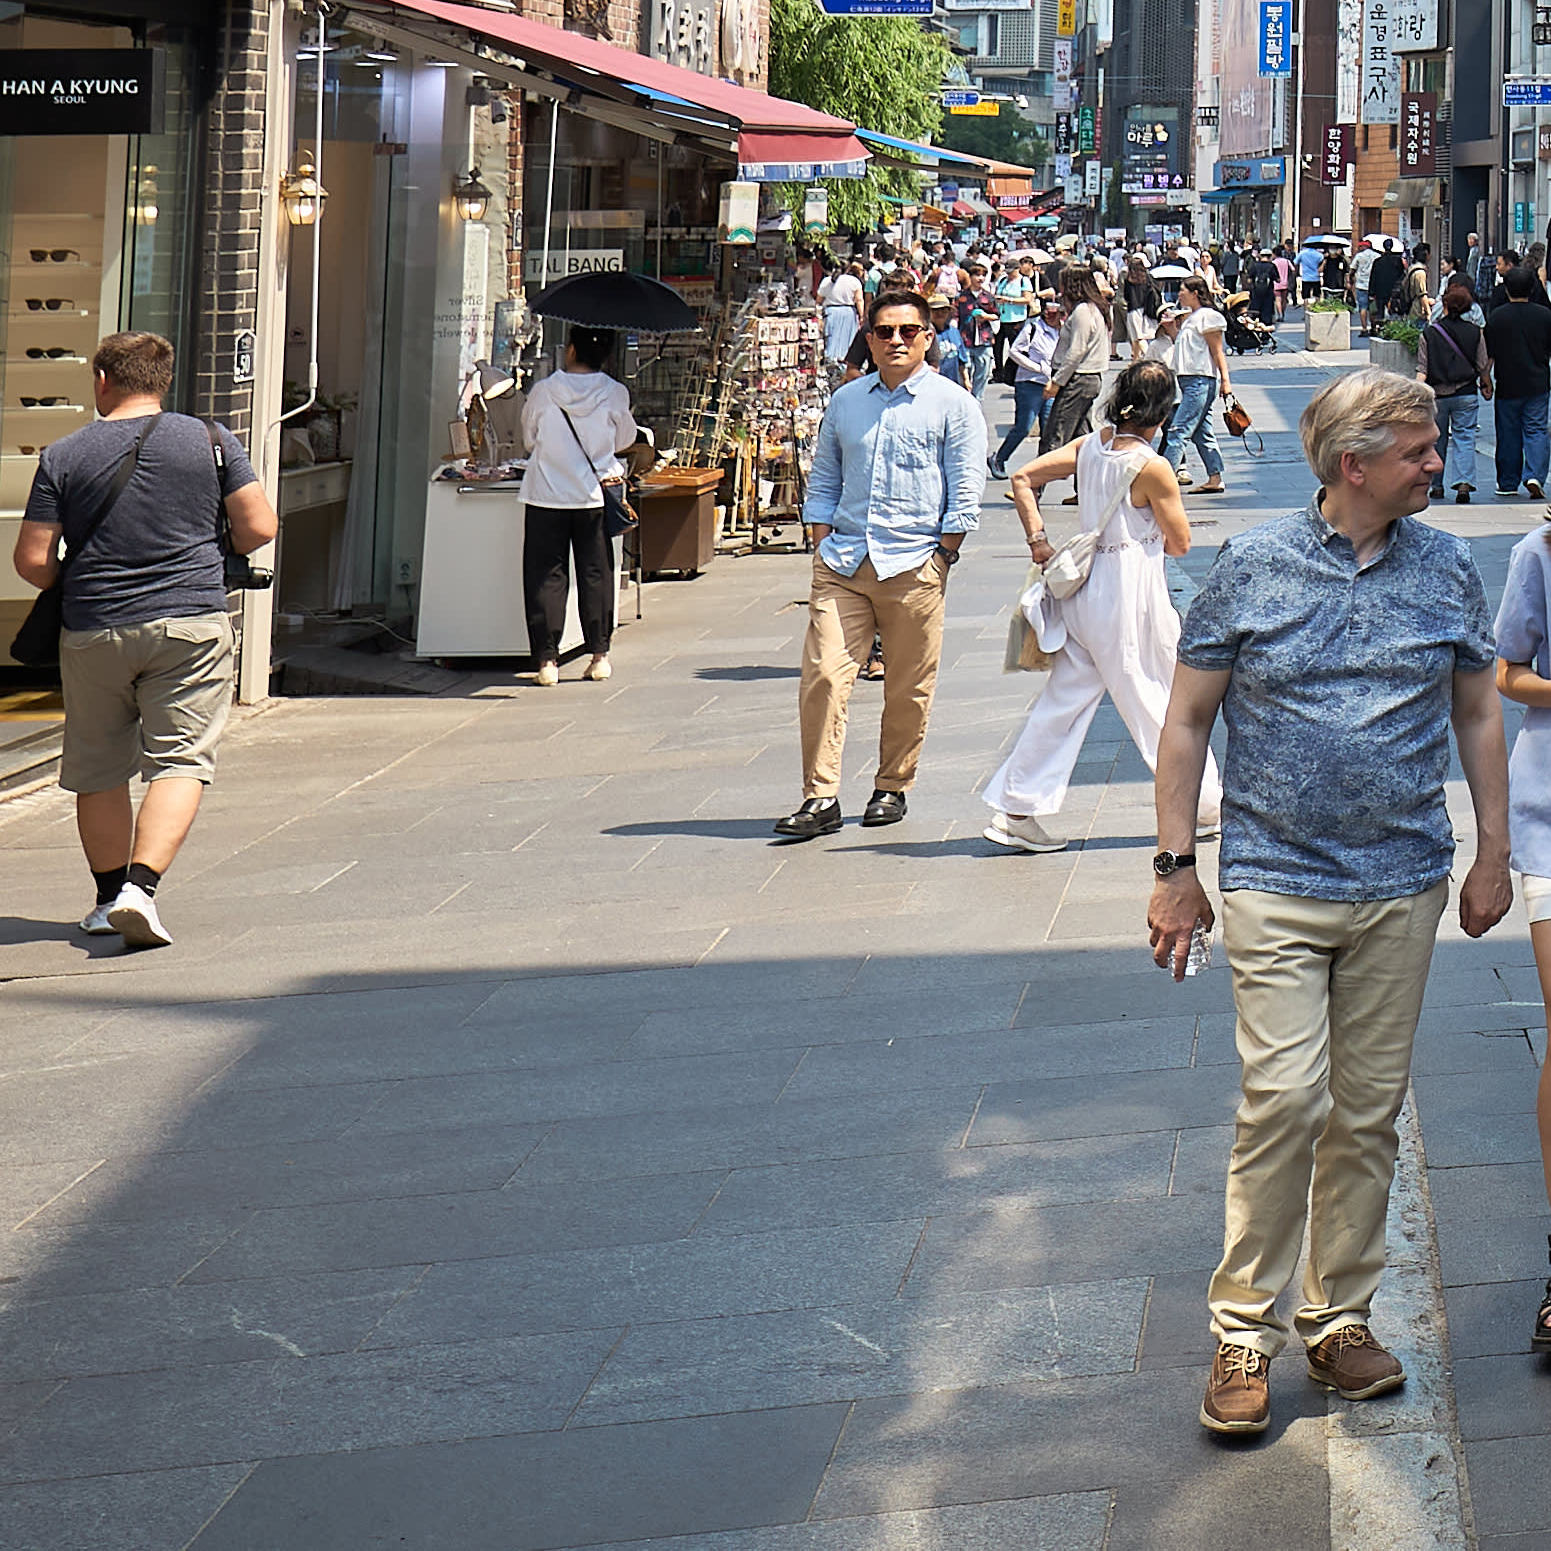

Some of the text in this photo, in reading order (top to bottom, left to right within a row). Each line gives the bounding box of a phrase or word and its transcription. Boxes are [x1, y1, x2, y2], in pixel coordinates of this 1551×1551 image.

[1368, 3, 1389, 104] 운경표구사
[2, 79, 139, 95] HAN A KYUNG
[53, 95, 87, 104] SEOUL
[568, 257, 620, 273] BANG
